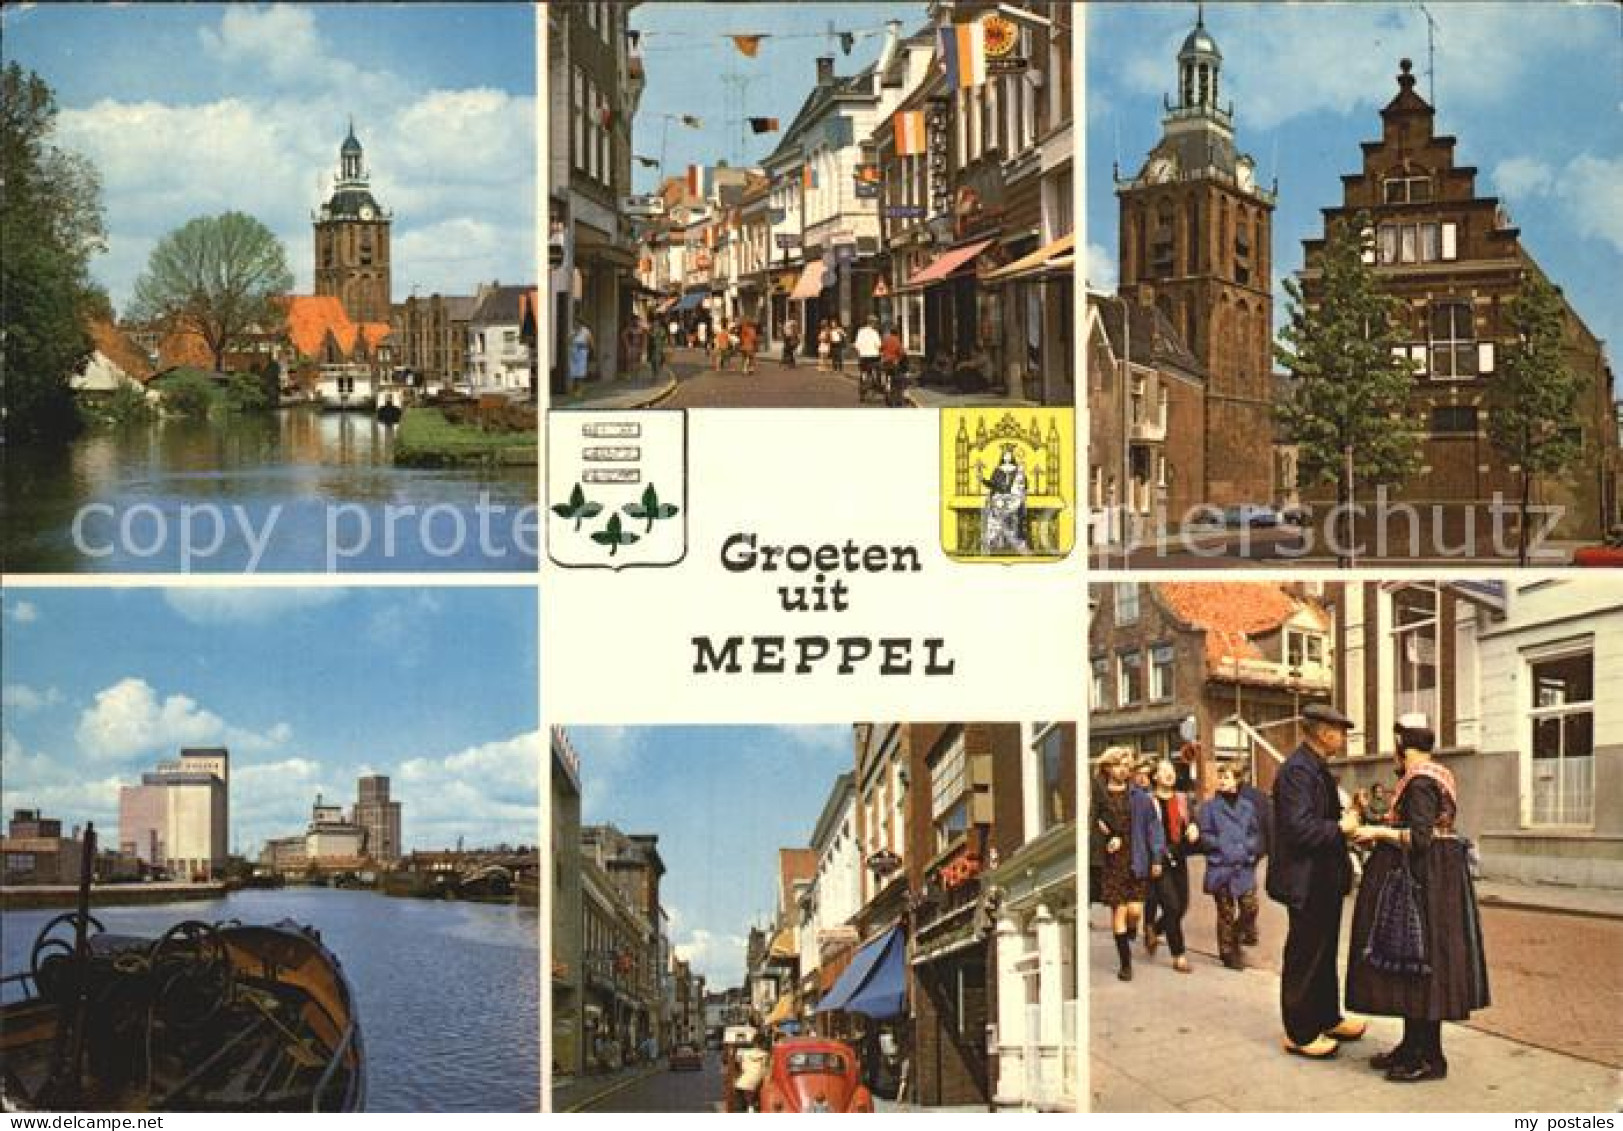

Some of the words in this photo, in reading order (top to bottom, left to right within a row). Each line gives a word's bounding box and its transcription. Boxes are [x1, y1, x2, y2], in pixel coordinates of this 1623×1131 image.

[720, 532, 922, 573] Groeten
[777, 573, 849, 612] uit
[690, 635, 956, 676] MEPPEL
